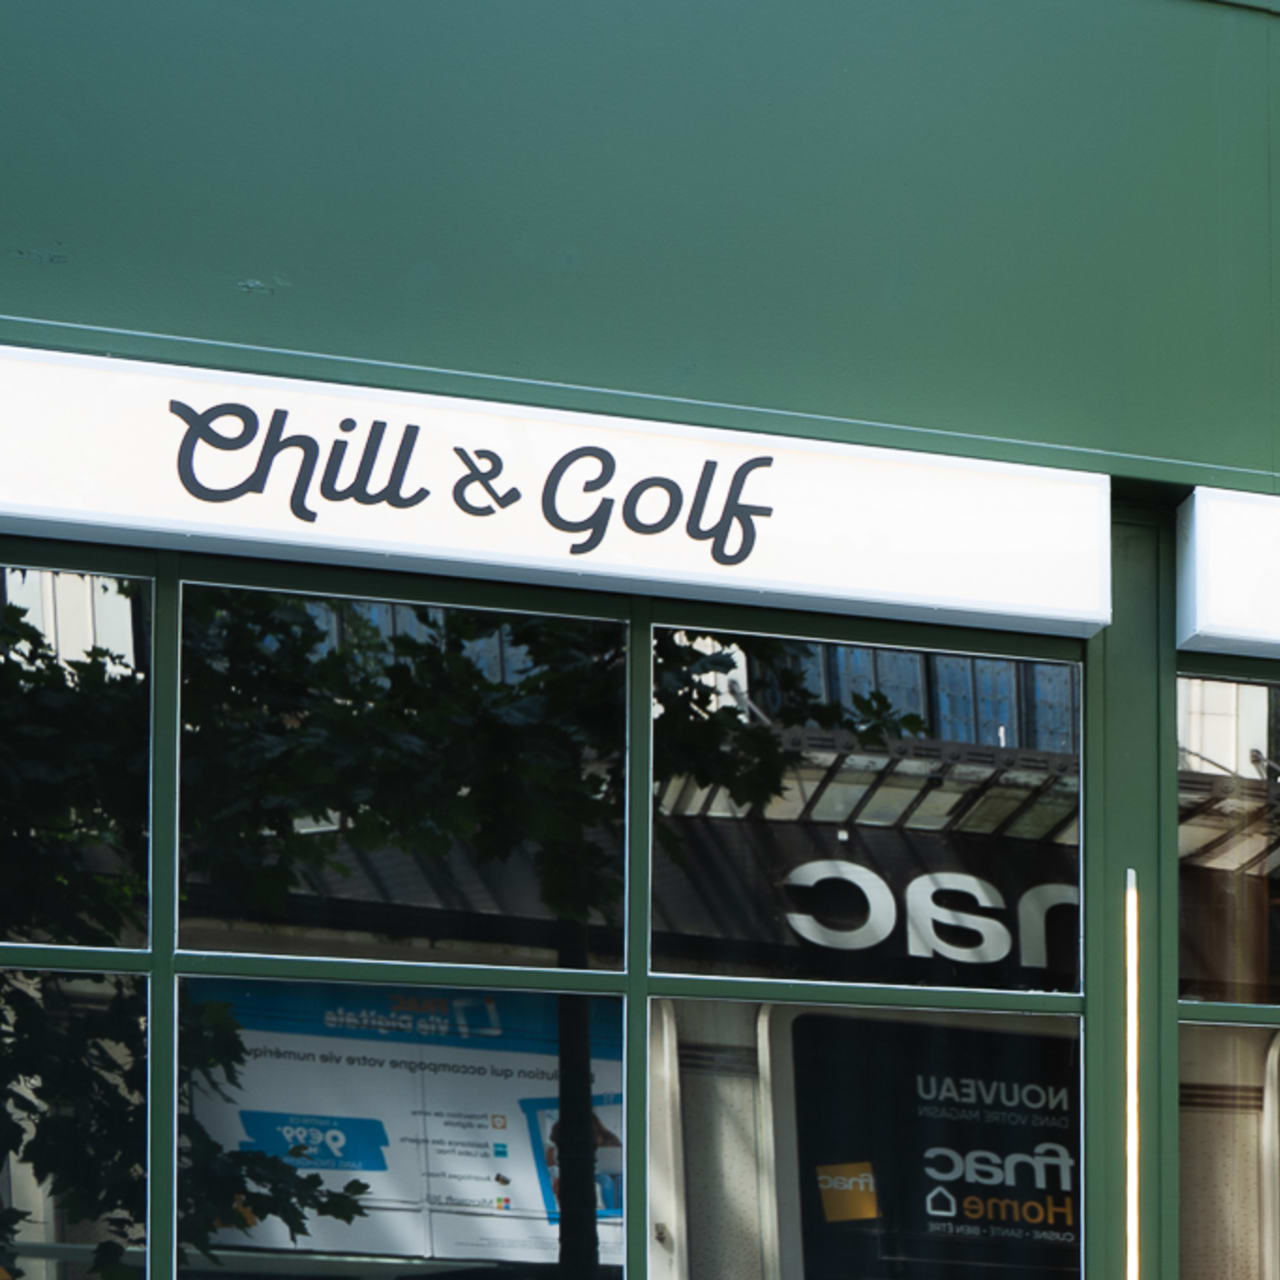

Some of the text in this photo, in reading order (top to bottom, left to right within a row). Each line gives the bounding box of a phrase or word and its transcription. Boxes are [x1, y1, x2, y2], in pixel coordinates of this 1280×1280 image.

[168, 399, 774, 566] Chill & Golf
